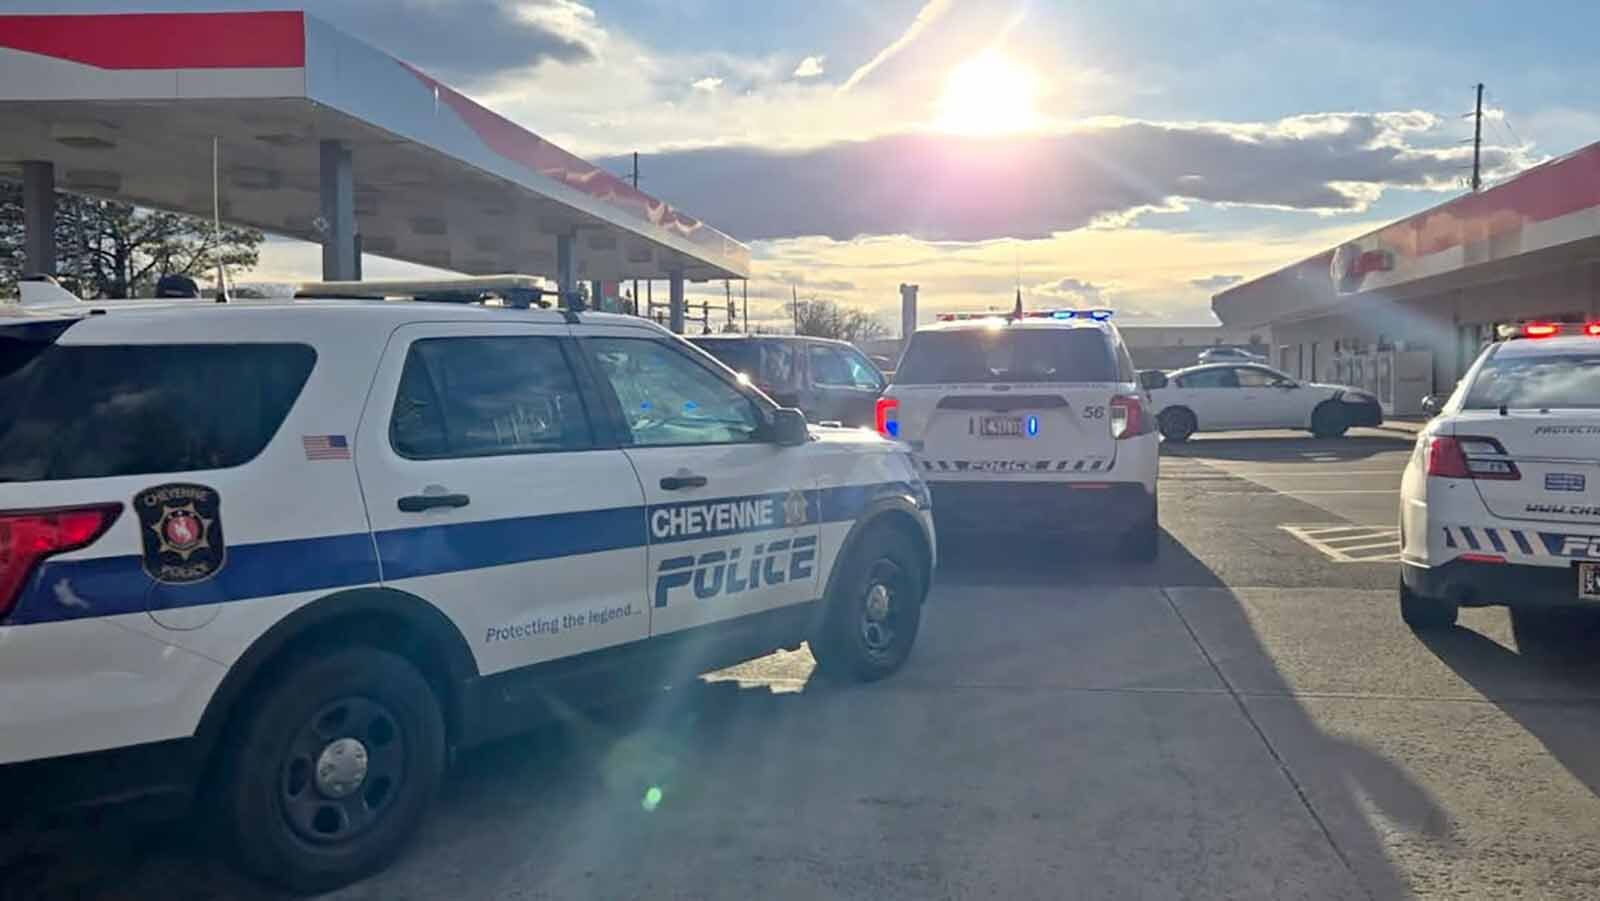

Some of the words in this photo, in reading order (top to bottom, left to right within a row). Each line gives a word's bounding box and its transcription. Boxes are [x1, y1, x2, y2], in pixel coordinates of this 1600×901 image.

[1082, 406, 1105, 419] 56
[651, 499, 774, 538] CHEYENNE
[655, 535, 818, 608] POLICE
[486, 618, 560, 643] Protecting
[563, 613, 585, 630] the
